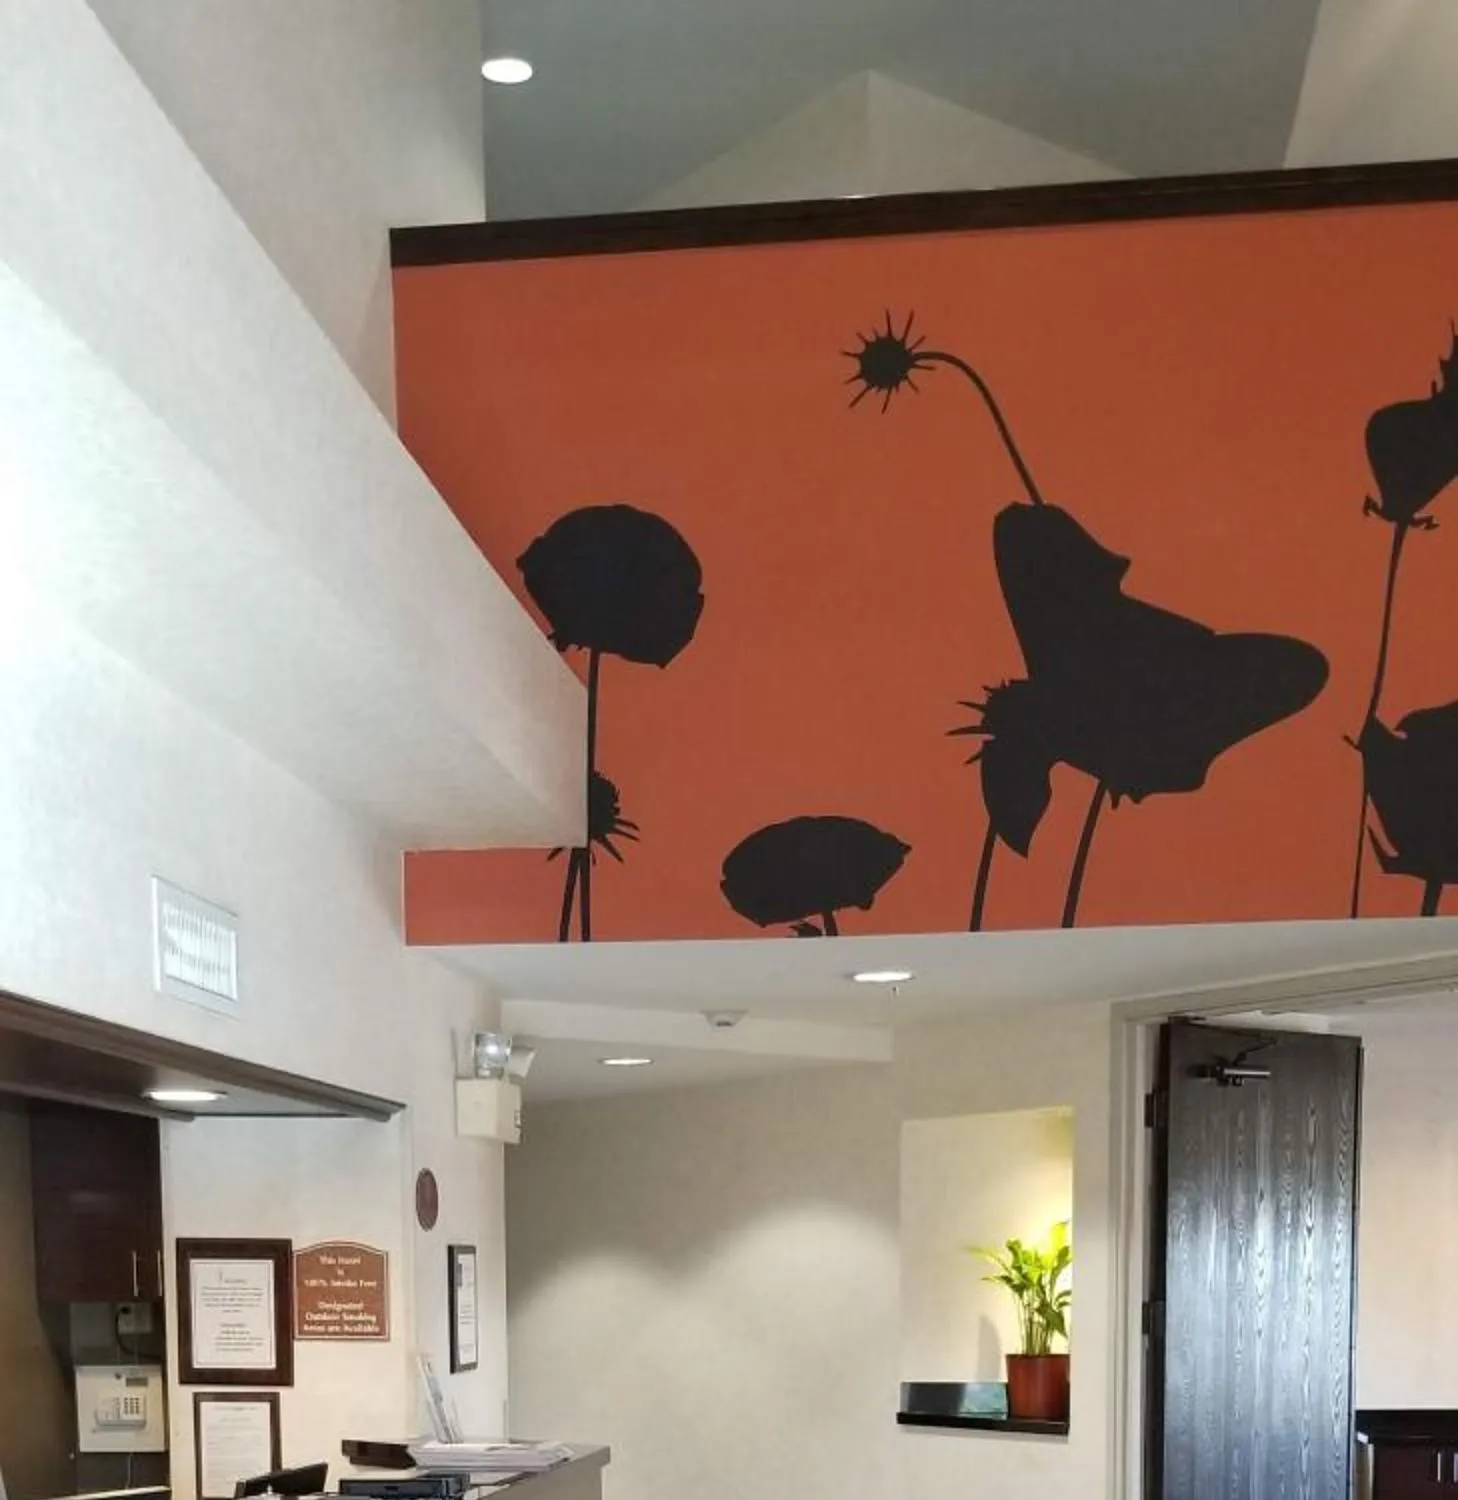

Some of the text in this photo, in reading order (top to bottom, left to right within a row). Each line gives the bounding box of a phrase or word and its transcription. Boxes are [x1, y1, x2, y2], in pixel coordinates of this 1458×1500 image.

[318, 1301, 364, 1312] Designated
[305, 1311, 377, 1323] Outdoor Smoking
[344, 1323, 380, 1332] Available
